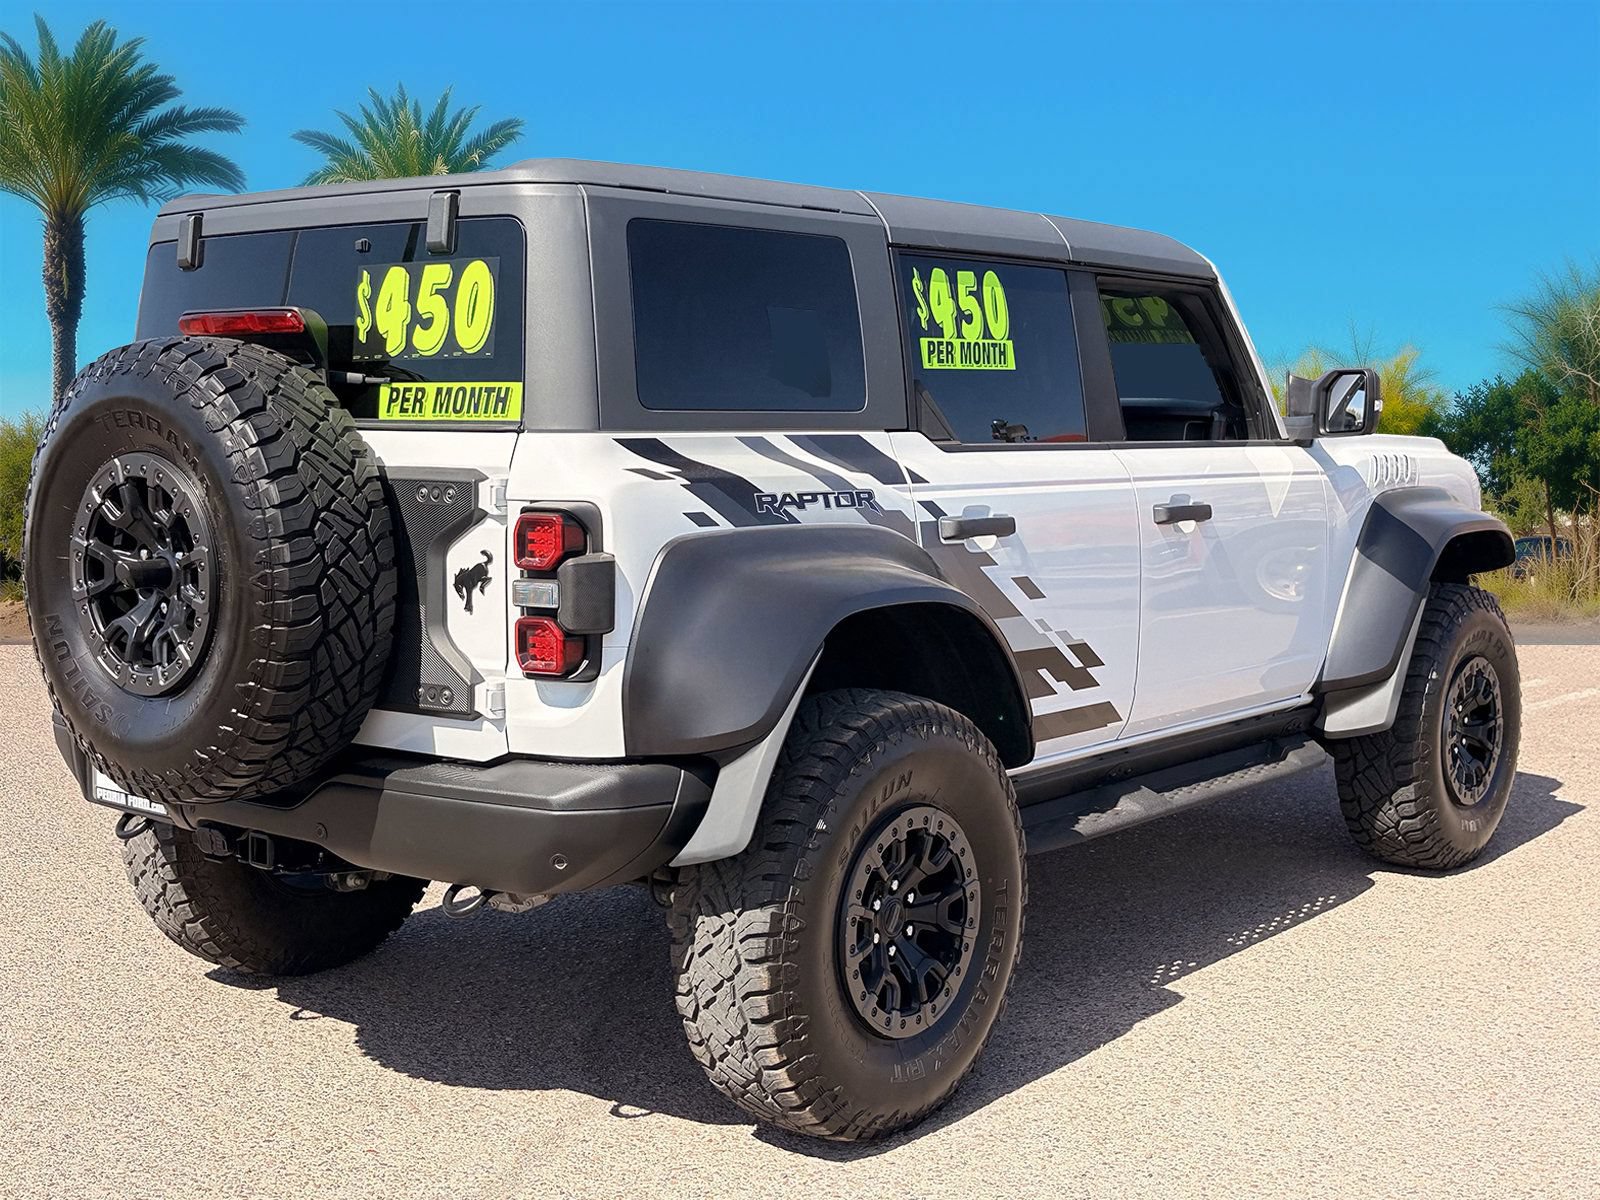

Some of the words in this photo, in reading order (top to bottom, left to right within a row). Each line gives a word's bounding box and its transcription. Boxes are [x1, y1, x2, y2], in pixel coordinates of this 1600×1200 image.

[356, 260, 495, 357] $450
[912, 267, 1009, 341] $450
[927, 341, 956, 367] PER
[960, 341, 1008, 367] MONTH
[387, 387, 427, 417] PER
[432, 386, 513, 417] MONTH
[754, 489, 883, 523] RAPTOR
[41, 614, 114, 724] SAILUN
[838, 769, 913, 870] SAILUN
